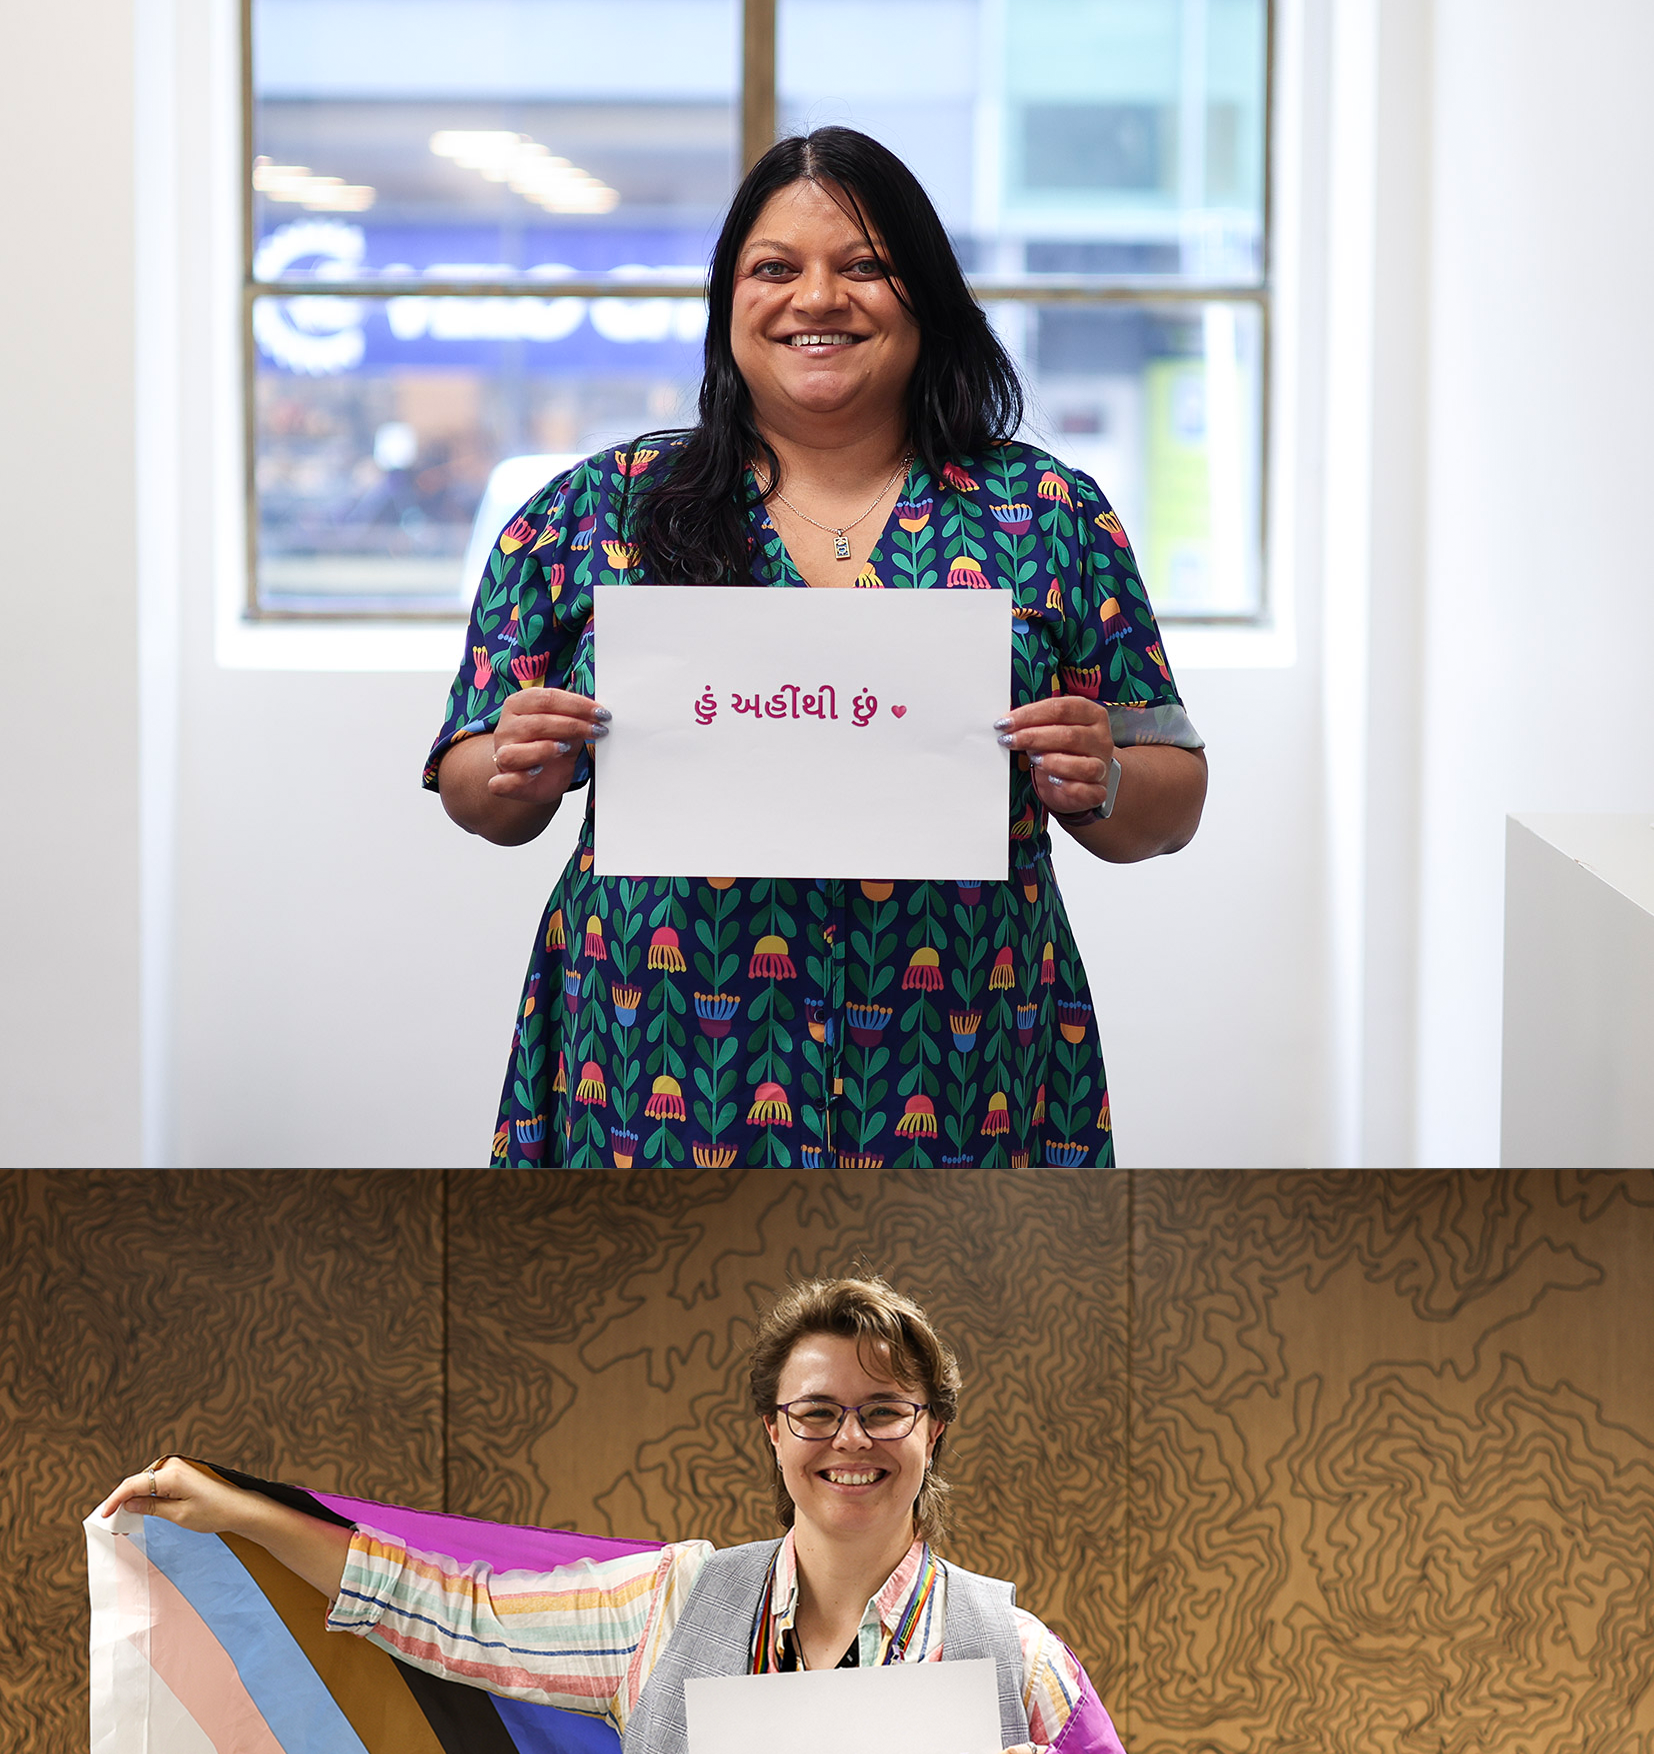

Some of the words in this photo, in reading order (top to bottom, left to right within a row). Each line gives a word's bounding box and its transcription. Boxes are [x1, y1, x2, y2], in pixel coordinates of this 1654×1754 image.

[694, 684, 718, 726] હું
[731, 684, 839, 720] અહીંથી
[851, 687, 878, 728] છું
